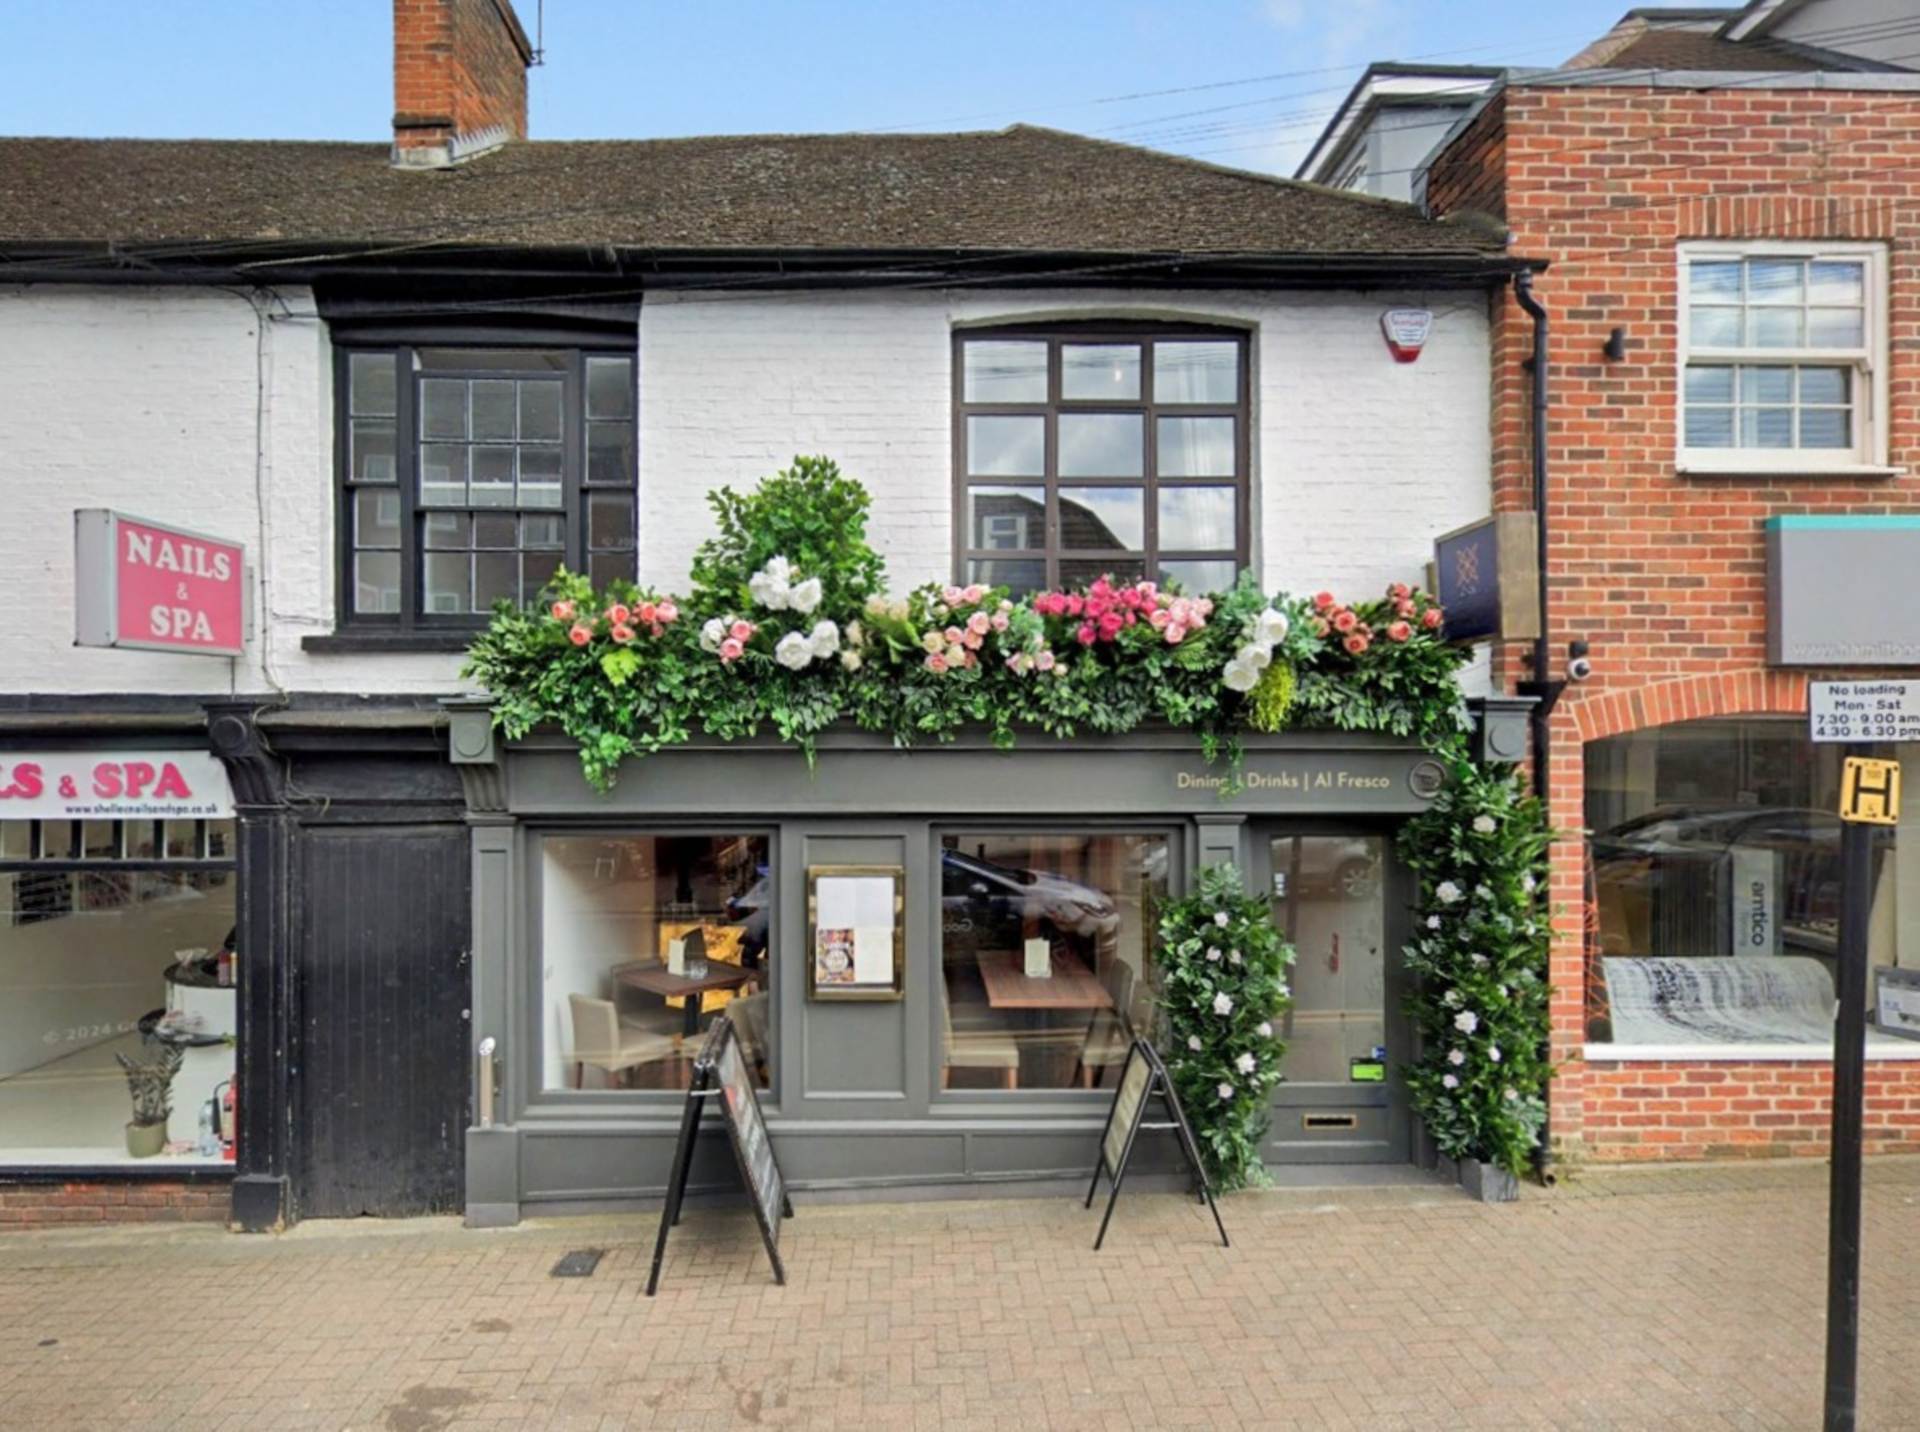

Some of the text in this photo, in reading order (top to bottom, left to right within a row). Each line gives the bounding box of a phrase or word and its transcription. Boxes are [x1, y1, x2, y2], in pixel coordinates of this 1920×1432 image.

[126, 530, 231, 581] NAILS
[176, 583, 188, 600] &
[150, 605, 214, 642] SPA
[1829, 685, 1906, 696] No loading
[1834, 700, 1865, 710] Mon
[1876, 700, 1901, 710] Sat
[1816, 714, 1849, 724] 7.30
[1860, 714, 1896, 724] 9.00
[1899, 715, 1920, 723] am
[1816, 726, 1851, 736] 4.30
[1862, 726, 1896, 736] 6.30
[0, 762, 192, 799] S & SPA
[1247, 770, 1298, 788] Drinks
[1314, 771, 1332, 788] Al
[1337, 771, 1391, 788] Fresco
[1851, 765, 1892, 817] H
[1752, 881, 1769, 946] amtico
